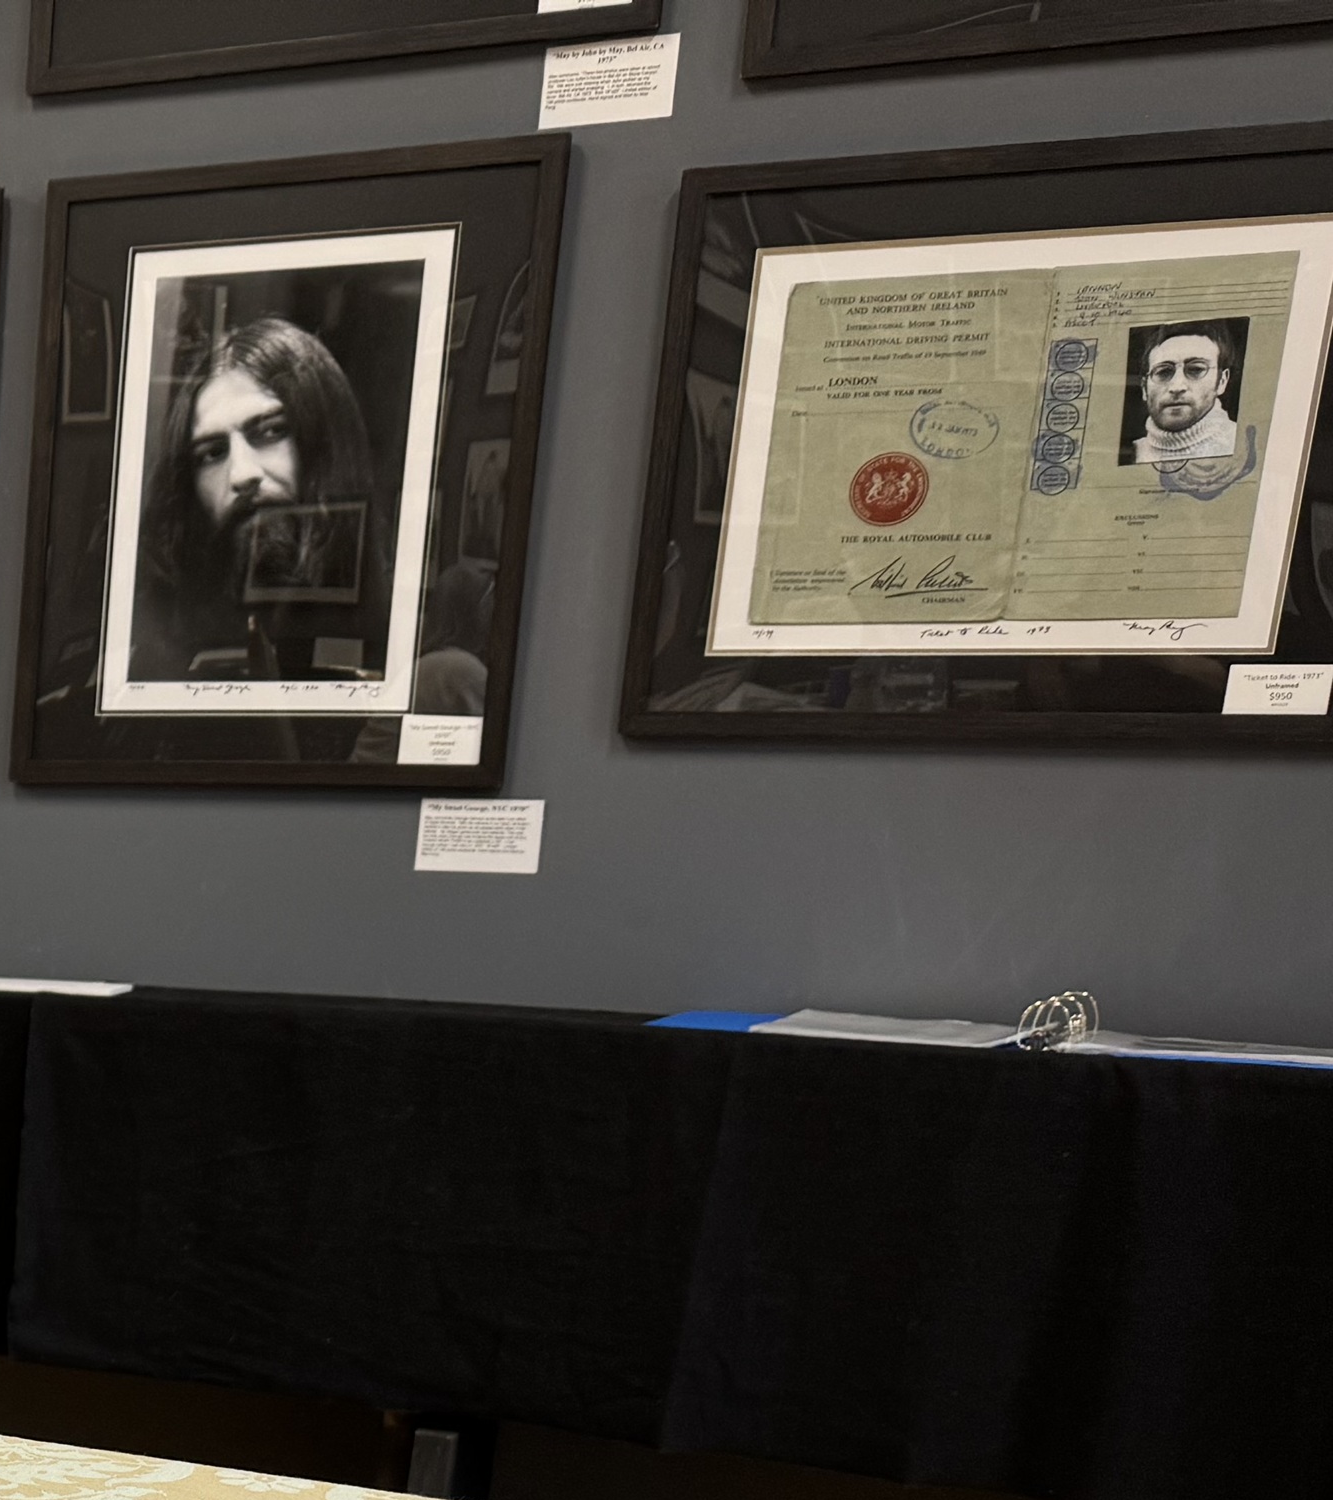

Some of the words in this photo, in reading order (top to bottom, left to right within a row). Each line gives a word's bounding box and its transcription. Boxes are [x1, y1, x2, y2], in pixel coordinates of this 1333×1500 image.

[819, 295, 856, 305] UNITED
[859, 293, 907, 304] KINGDOM
[910, 292, 925, 301] OF
[928, 290, 963, 300] GREAT
[966, 288, 1008, 298] BRITAIN
[846, 306, 868, 315] AND
[872, 303, 927, 314] NORTHERN
[931, 301, 975, 311] IRELAND
[824, 337, 902, 349] INTERNATIONAL
[906, 335, 949, 345] DRIVING
[952, 332, 990, 343] PERMIT
[829, 375, 878, 388] LONDON
[840, 535, 859, 544] THE
[862, 534, 895, 544] ROYAL
[898, 533, 961, 542] AUTOMOBILE
[965, 533, 992, 542] CLUB
[1269, 691, 1293, 701] $950
